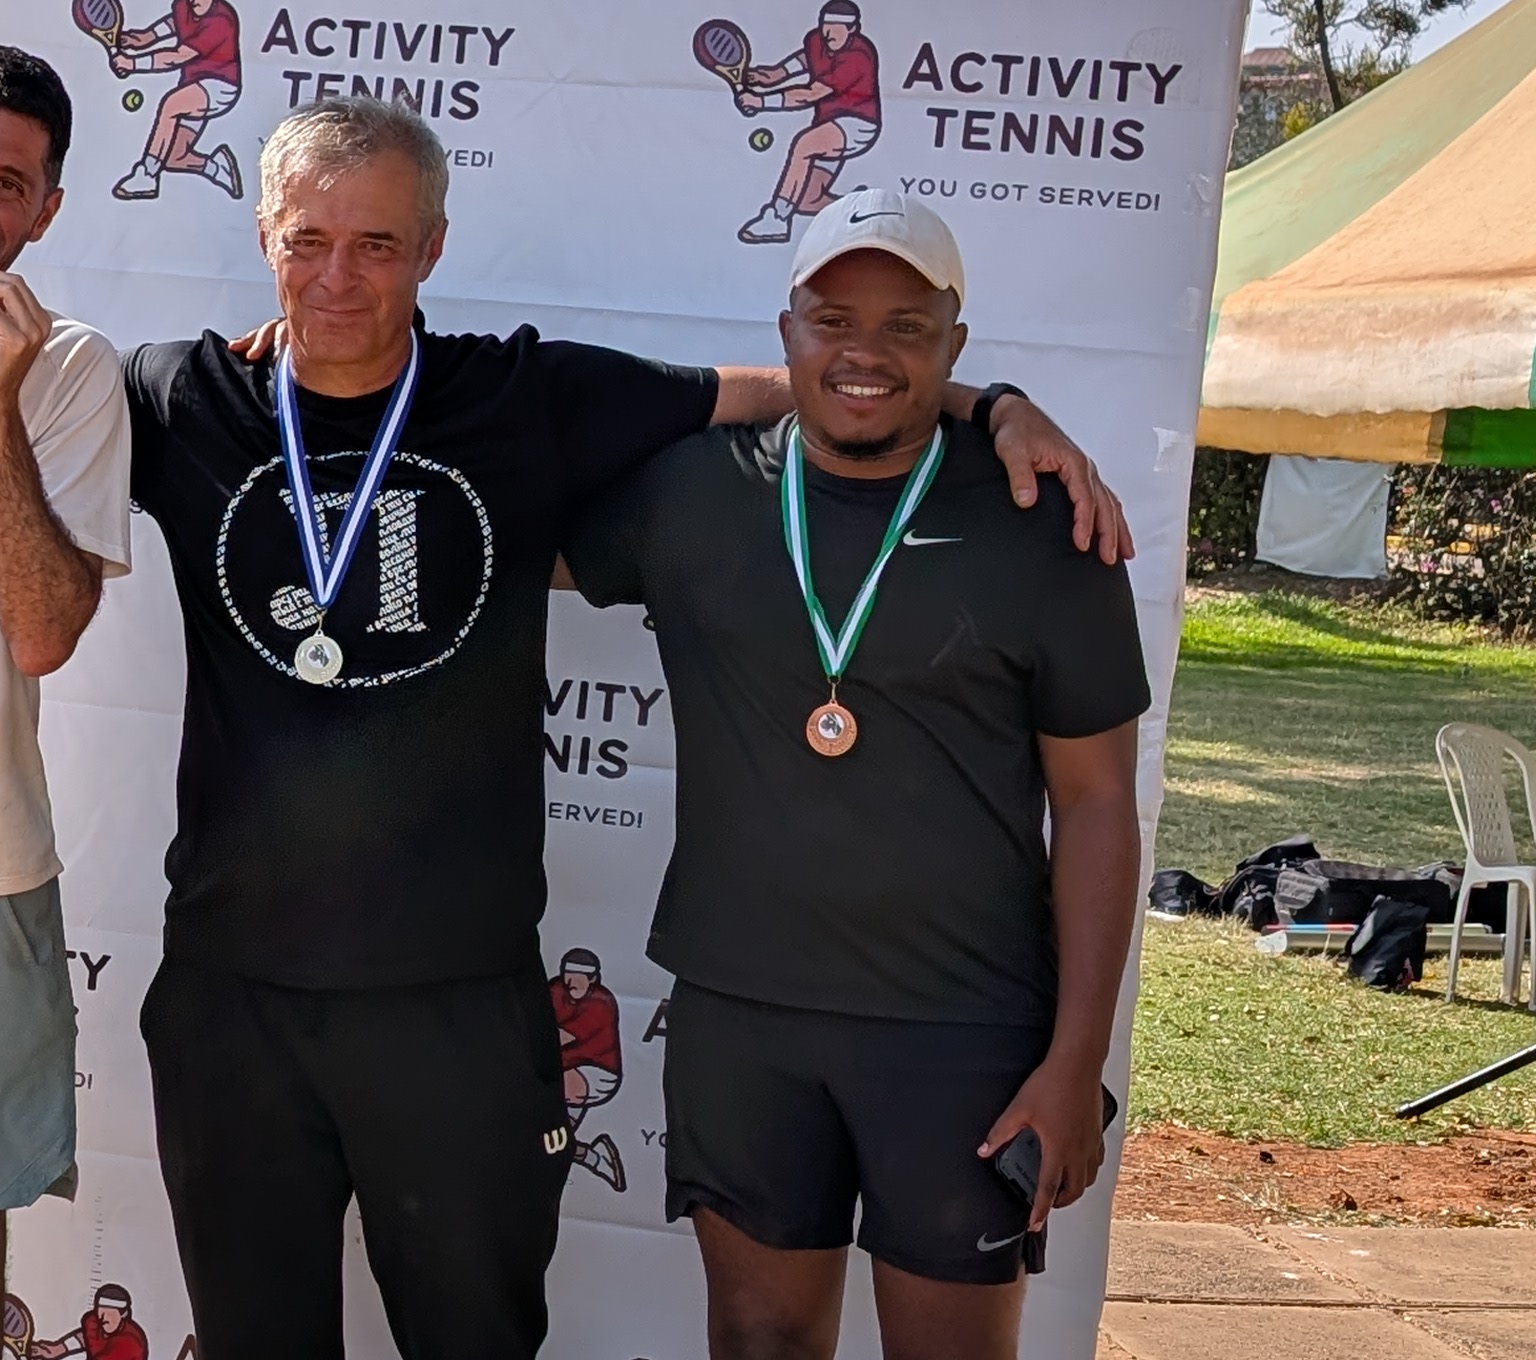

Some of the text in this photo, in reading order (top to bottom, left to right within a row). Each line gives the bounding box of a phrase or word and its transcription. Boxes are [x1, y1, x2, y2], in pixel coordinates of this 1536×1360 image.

[260, 8, 516, 67] ACTIVITY
[902, 42, 1183, 105] ACTIVITY
[926, 107, 1145, 161] TENNIS
[899, 176, 1161, 212] YOU GOT SERVED!
[544, 679, 665, 727] VITY
[544, 732, 629, 780] NIS
[548, 801, 644, 829] ERVED!
